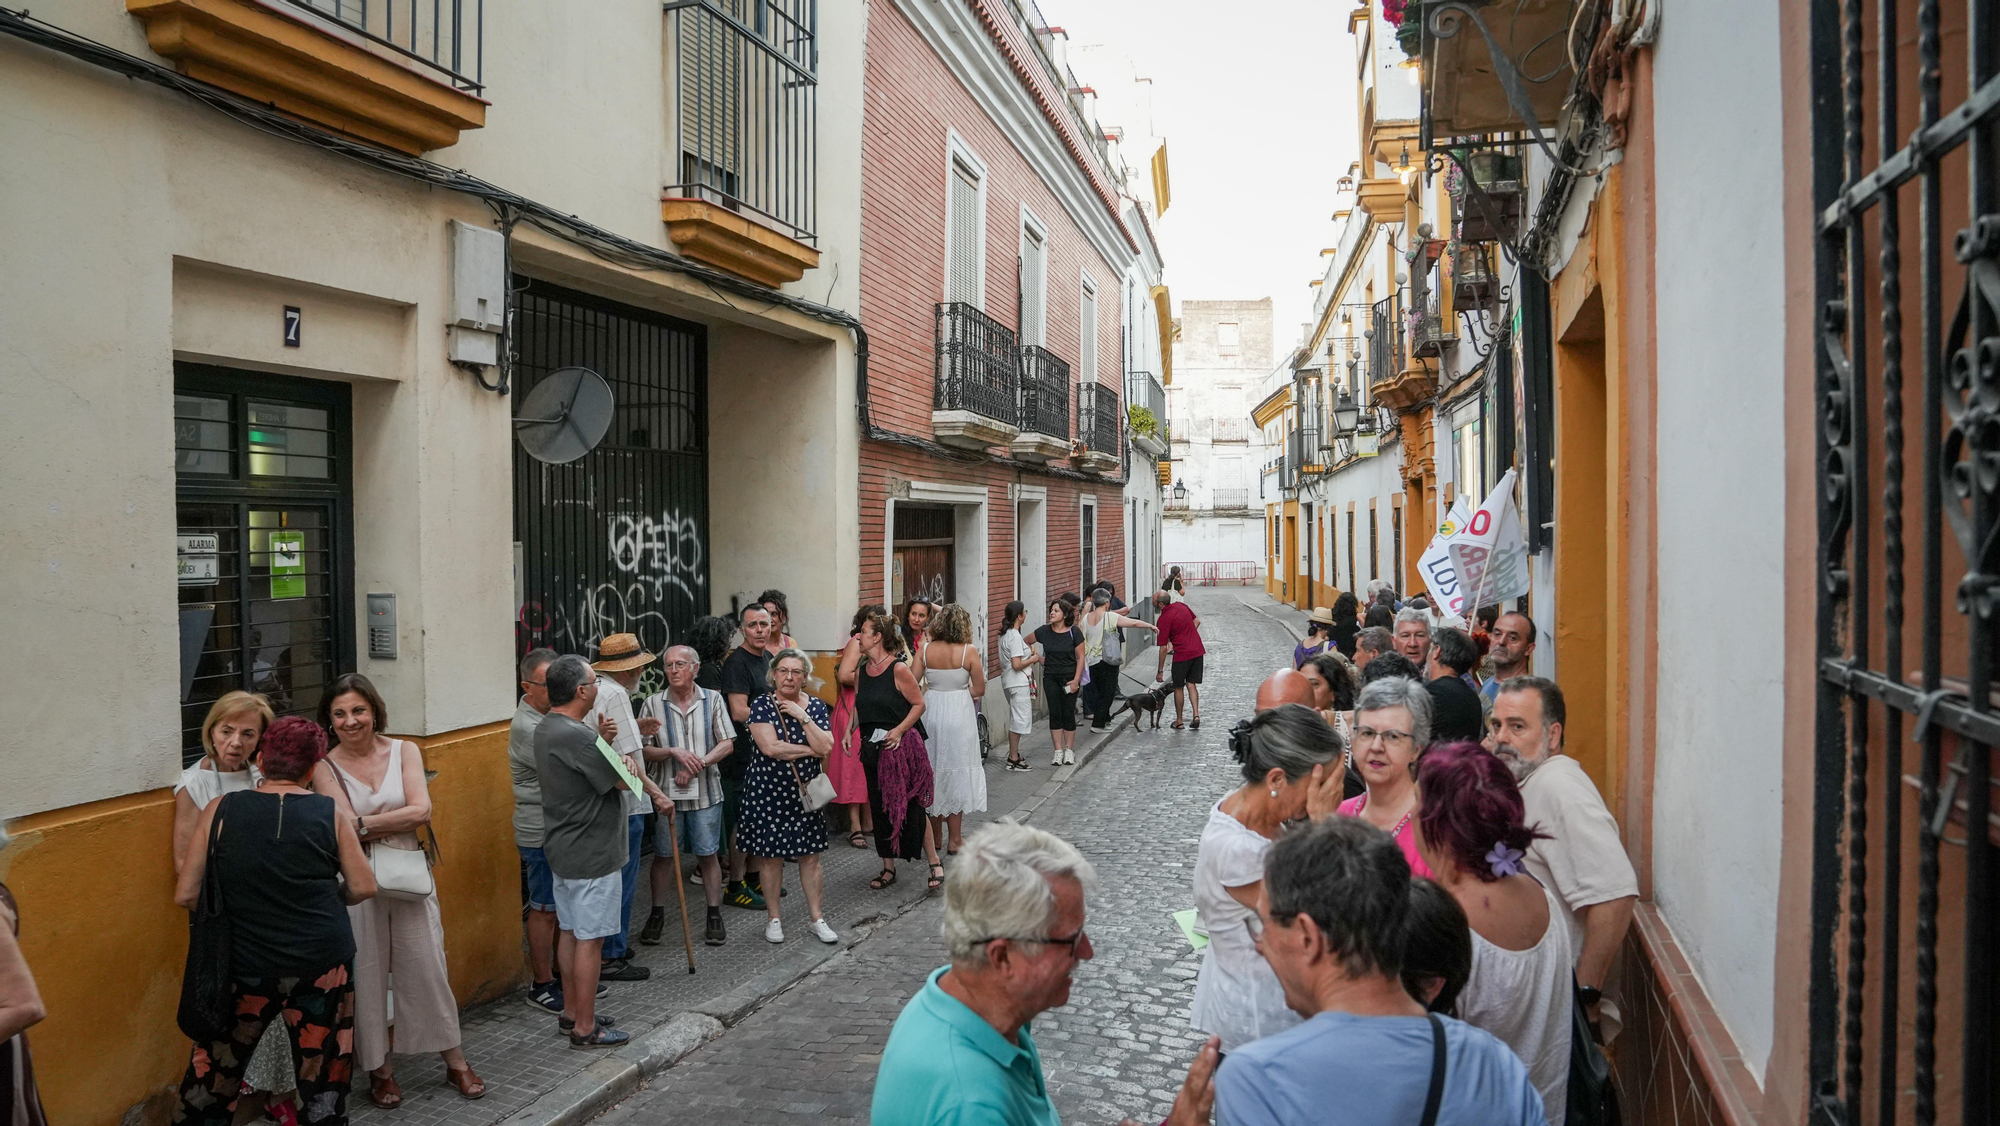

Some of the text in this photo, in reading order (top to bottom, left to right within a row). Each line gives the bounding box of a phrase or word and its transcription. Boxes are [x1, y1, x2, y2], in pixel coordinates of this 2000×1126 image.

[286, 310, 300, 341] 7
[188, 539, 216, 550] ALARMA
[1427, 555, 1459, 596] LOS
